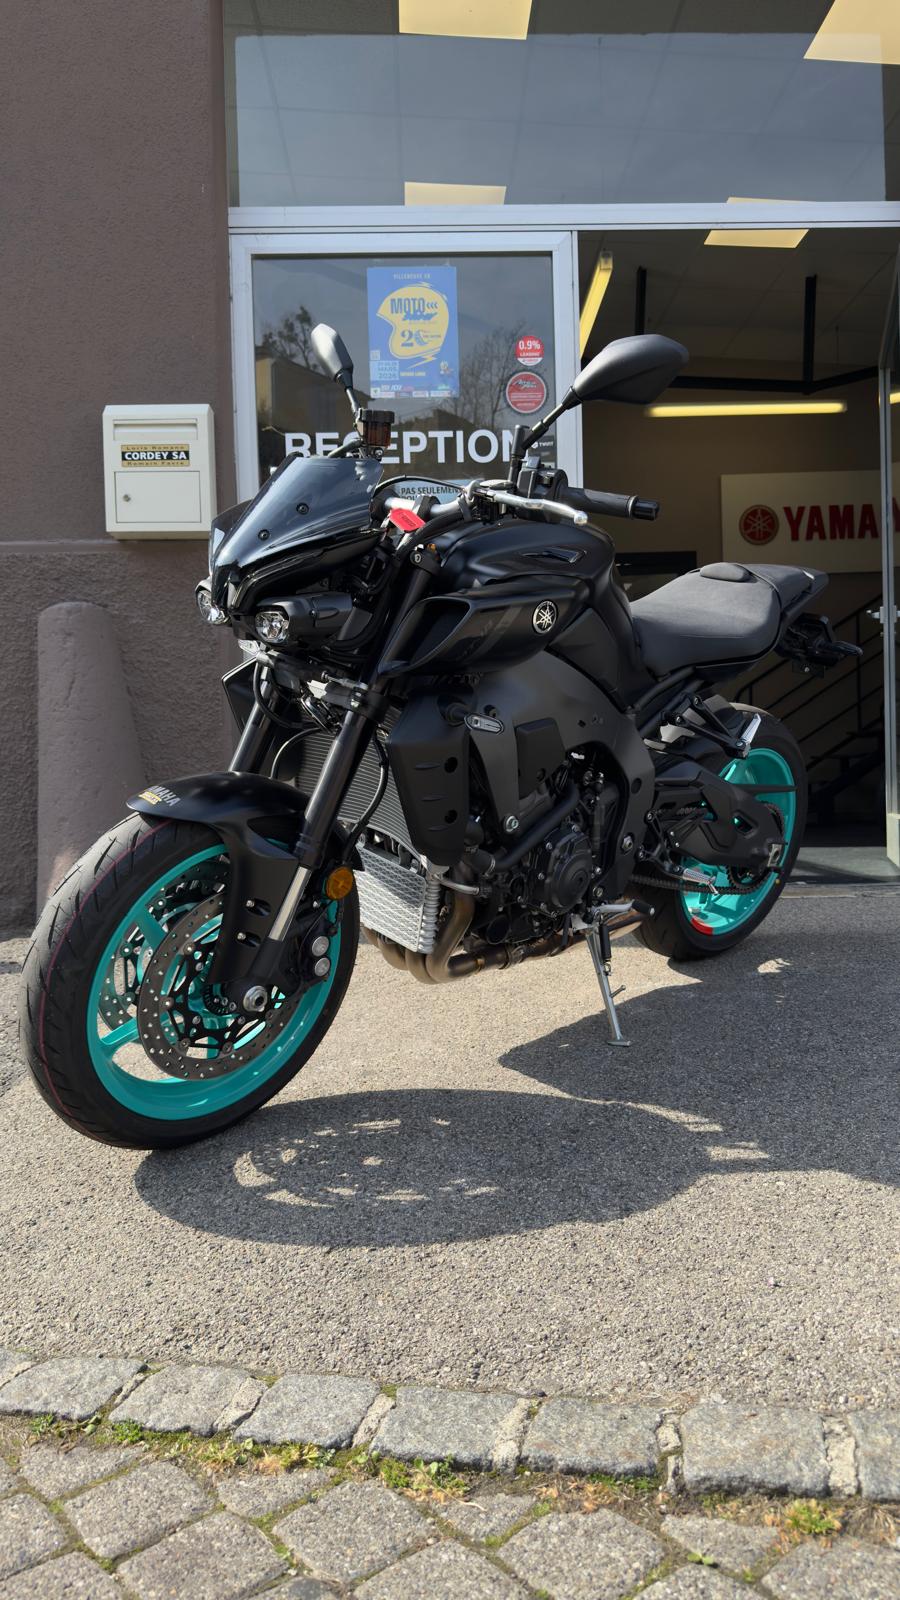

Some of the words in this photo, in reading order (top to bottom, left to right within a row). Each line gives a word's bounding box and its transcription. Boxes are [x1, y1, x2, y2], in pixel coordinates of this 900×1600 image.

[390, 298, 425, 314] MOTO
[518, 340, 541, 350] 0.9%
[124, 451, 169, 460] CORDEY
[172, 451, 187, 460] SA
[417, 486, 460, 494] SEULEMEN
